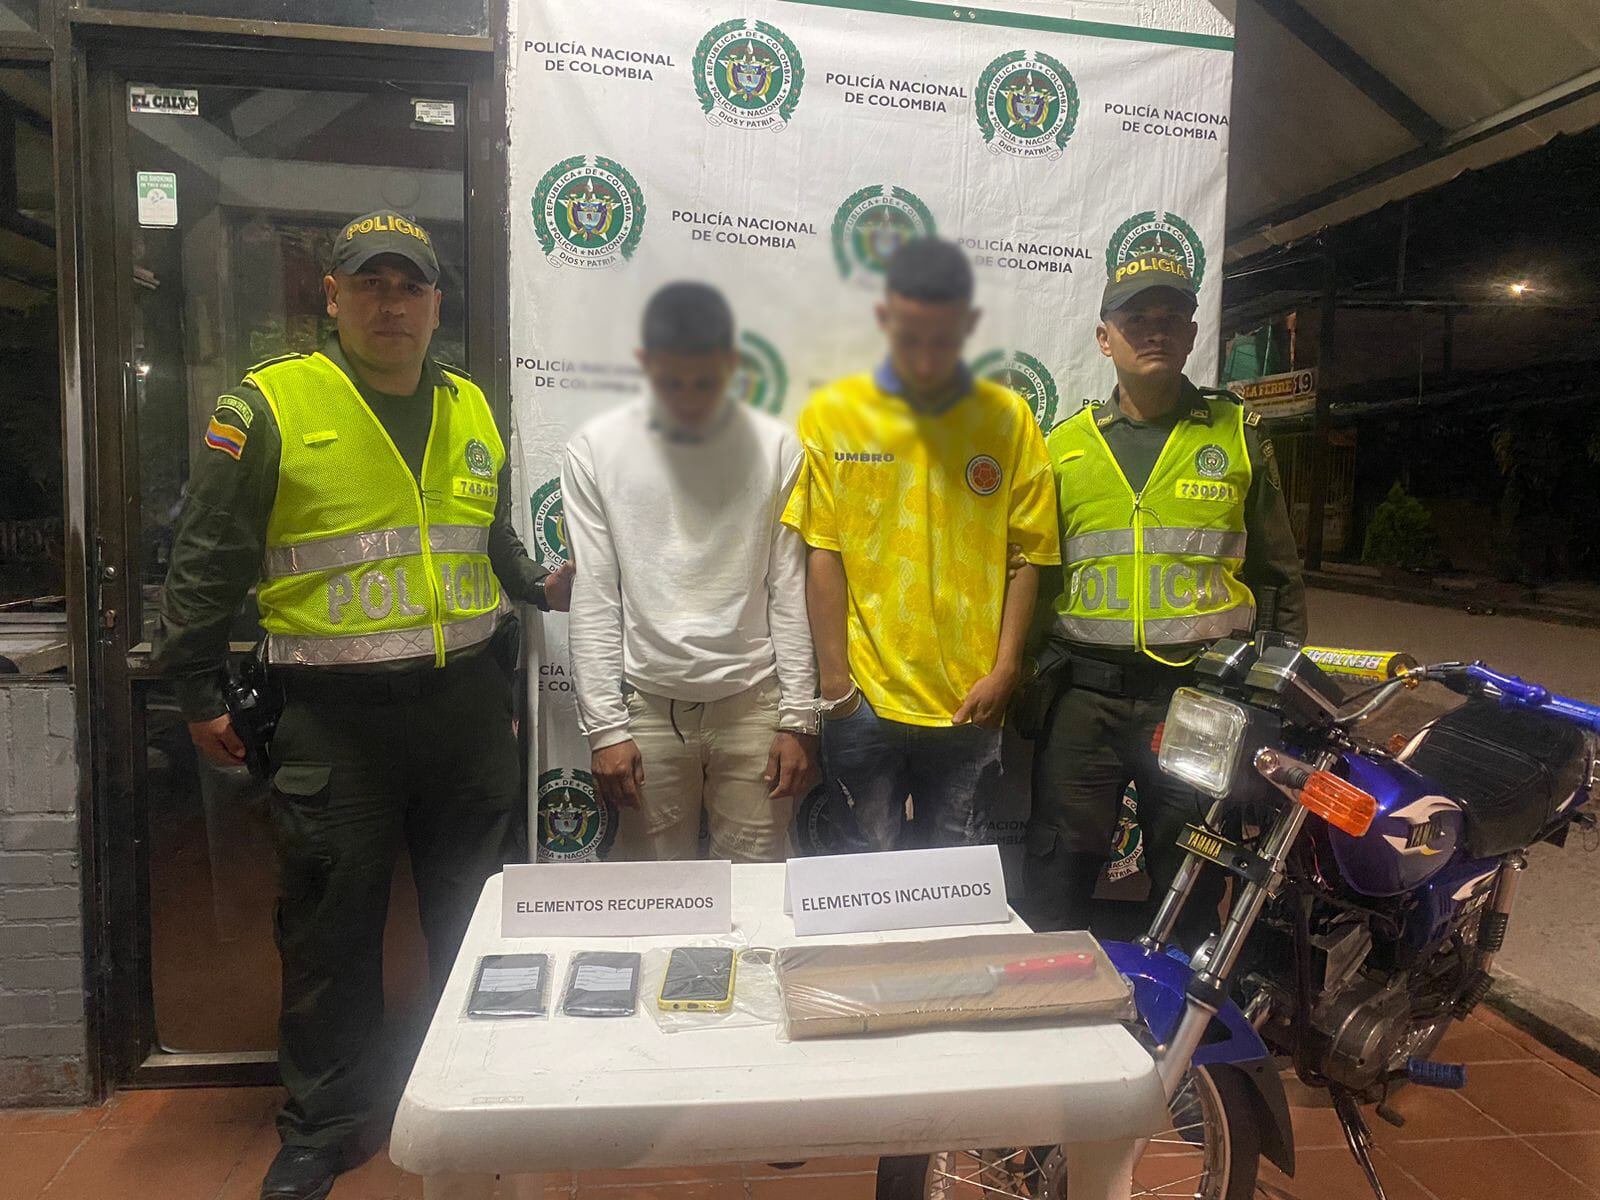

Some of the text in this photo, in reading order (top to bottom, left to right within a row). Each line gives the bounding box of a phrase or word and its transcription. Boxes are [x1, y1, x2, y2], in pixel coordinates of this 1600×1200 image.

[524, 40, 675, 67] POLICÍA NACIONAL
[707, 33, 737, 76] REPUBLICA
[766, 38, 791, 85] COLOMBIA
[545, 60, 654, 81] DE COLOMBIA
[826, 72, 967, 98] POLICÍA NACIONAL
[988, 64, 1017, 106] REPUBLICA
[1045, 69, 1067, 114] COLOMBIA
[132, 94, 149, 107] EL
[711, 87, 786, 117] POLICIA NACIONAL
[845, 92, 947, 113] DE COLOMBIA
[746, 117, 775, 127] PATRIA
[1104, 103, 1229, 126] POLICÍA NACIONA
[992, 118, 1061, 145] POLICIA NACIONAL
[1122, 121, 1218, 141] DE COLOMBIA
[1025, 145, 1051, 155] PATRIA
[546, 171, 577, 216] REPUBLICA
[606, 175, 632, 222] COLOMBIA
[346, 215, 429, 245] POLICIA
[672, 210, 817, 235] POLICÍA NACIONAL
[551, 226, 628, 256] POLICIA NACIONAL
[692, 229, 797, 249] DE COLOMBIA
[1018, 242, 1093, 259] NACIONAL
[1119, 225, 1146, 261] EPUBLICA
[587, 256, 616, 267] PATRIA
[997, 257, 1073, 274] COLOMBIA
[1115, 257, 1188, 283] POLICIA
[516, 357, 576, 372] POLICÍA
[535, 376, 555, 388] DE
[1023, 367, 1045, 411] COLOMBIA
[1294, 372, 1312, 395] 19
[834, 452, 895, 462] UMBRO
[1182, 483, 1233, 500] 730991
[537, 491, 560, 532] REPUBLIC
[328, 563, 492, 624] POLICIA
[1307, 650, 1383, 670] RENTHAL
[564, 836, 603, 859] NACIONAL
[1187, 831, 1223, 859] YAMAHA
[516, 897, 714, 913] ELEMENTOS RECUPERADOS
[802, 882, 991, 911] ELEMENTOS INCAUTADOS
